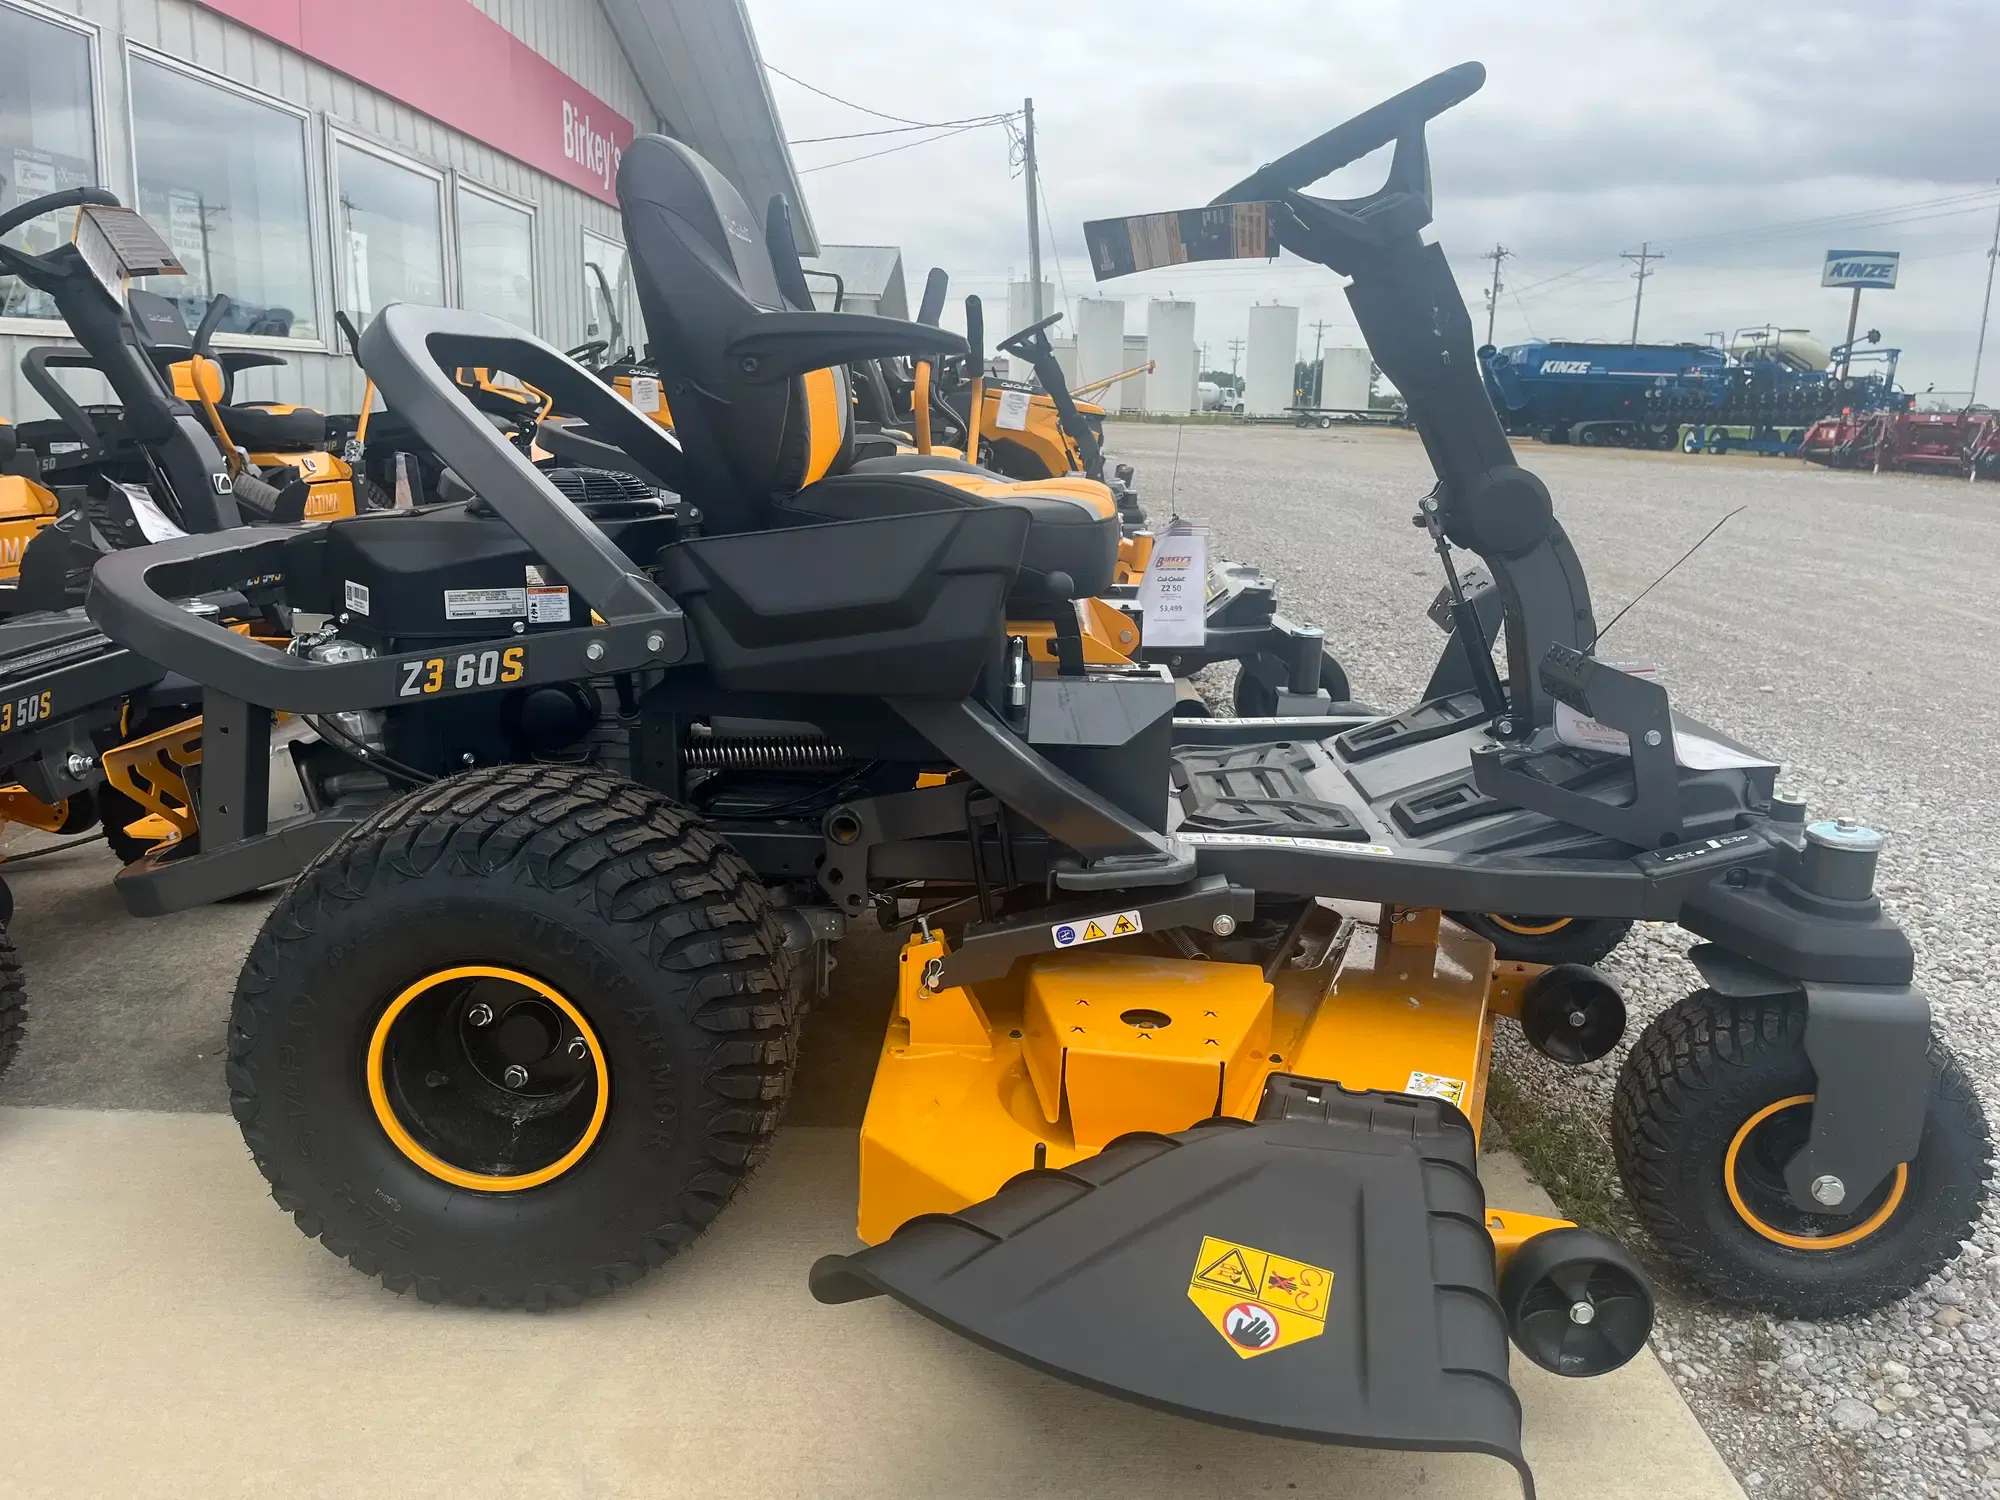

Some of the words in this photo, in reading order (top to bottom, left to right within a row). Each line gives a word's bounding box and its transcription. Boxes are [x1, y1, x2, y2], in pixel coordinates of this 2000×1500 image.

[562, 99, 621, 190] Birkey's
[1828, 262, 1895, 279] KINZE
[1539, 359, 1592, 376] KINZE
[1155, 556, 1192, 568] BIRKEY'S
[1161, 584, 1171, 592] Z2
[1172, 584, 1182, 592] 50
[1159, 604, 1183, 613] $3,499
[399, 657, 445, 697] Z3
[454, 646, 525, 689] 60S
[16, 690, 52, 727] 50S
